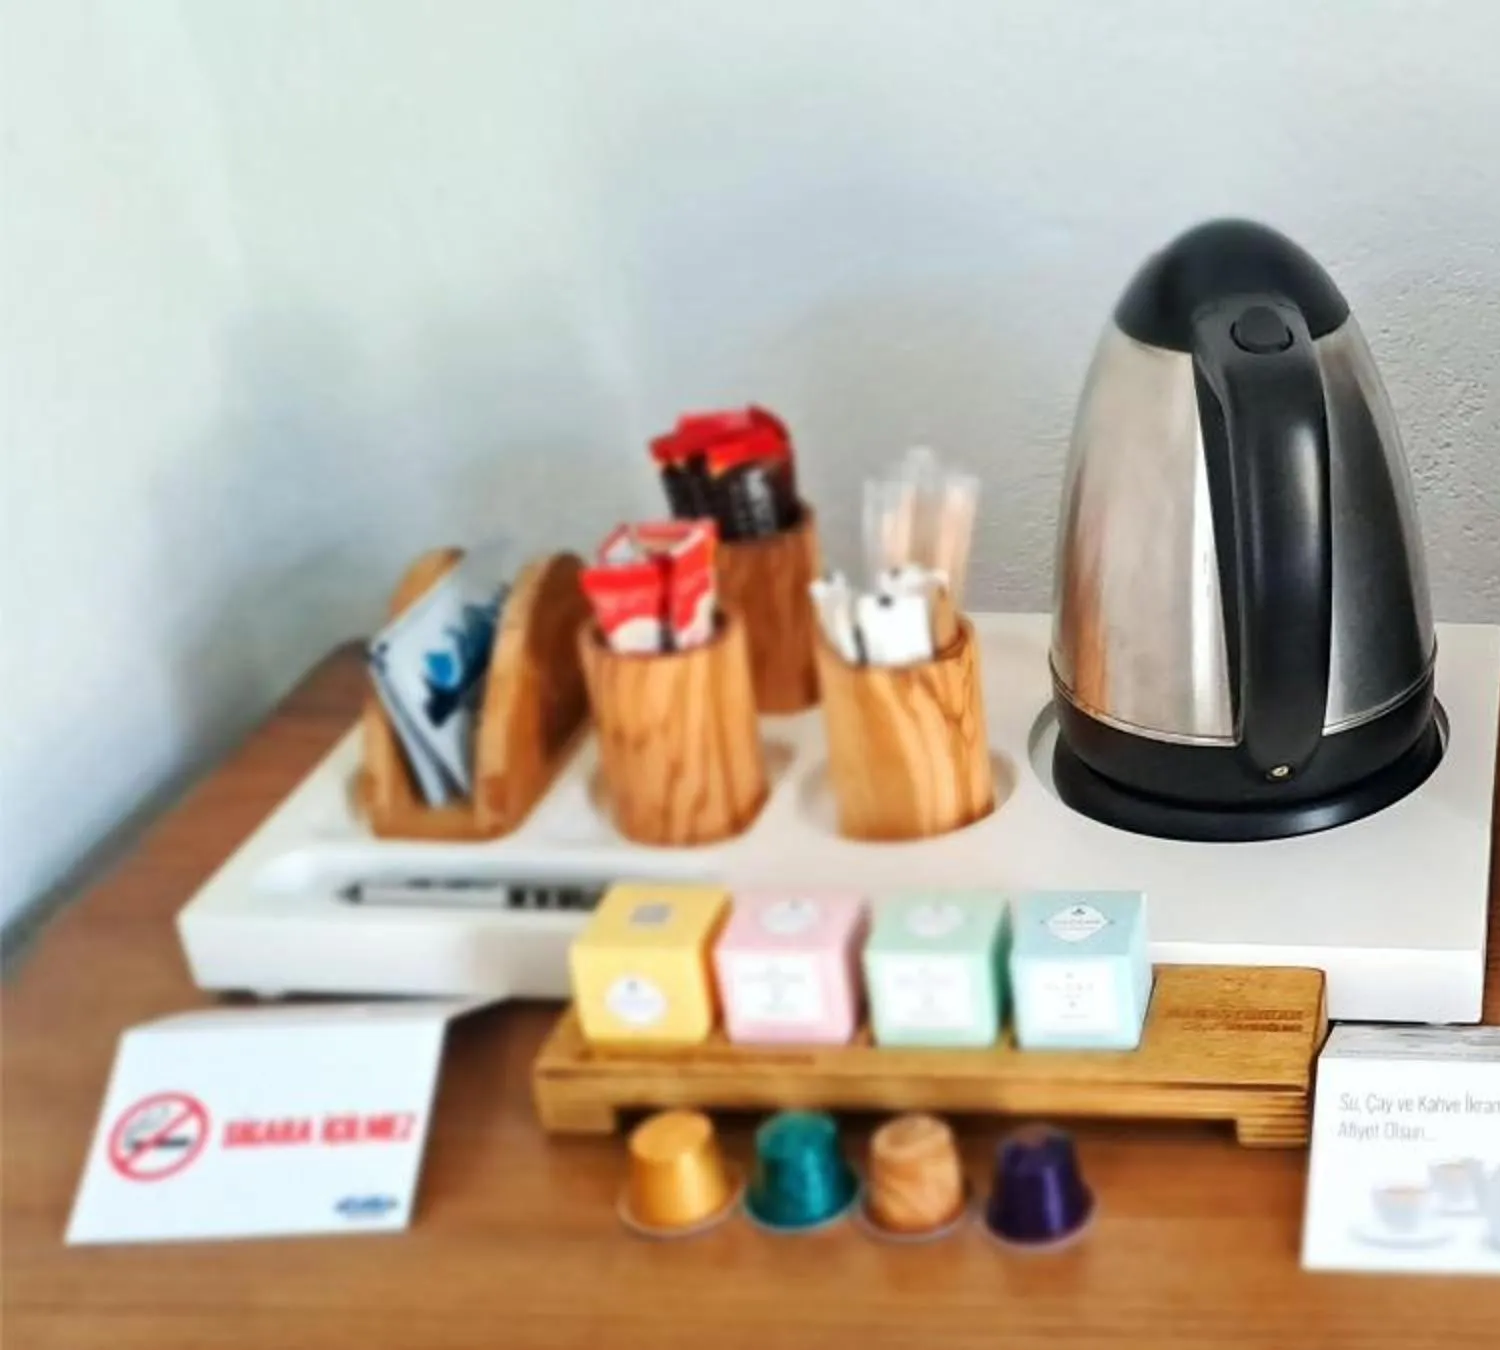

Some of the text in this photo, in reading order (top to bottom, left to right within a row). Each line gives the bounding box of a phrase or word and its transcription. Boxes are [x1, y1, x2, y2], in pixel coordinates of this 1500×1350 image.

[1365, 1092, 1392, 1115] Çay
[1397, 1098, 1414, 1112] ve
[1418, 1095, 1462, 1114] Kahve
